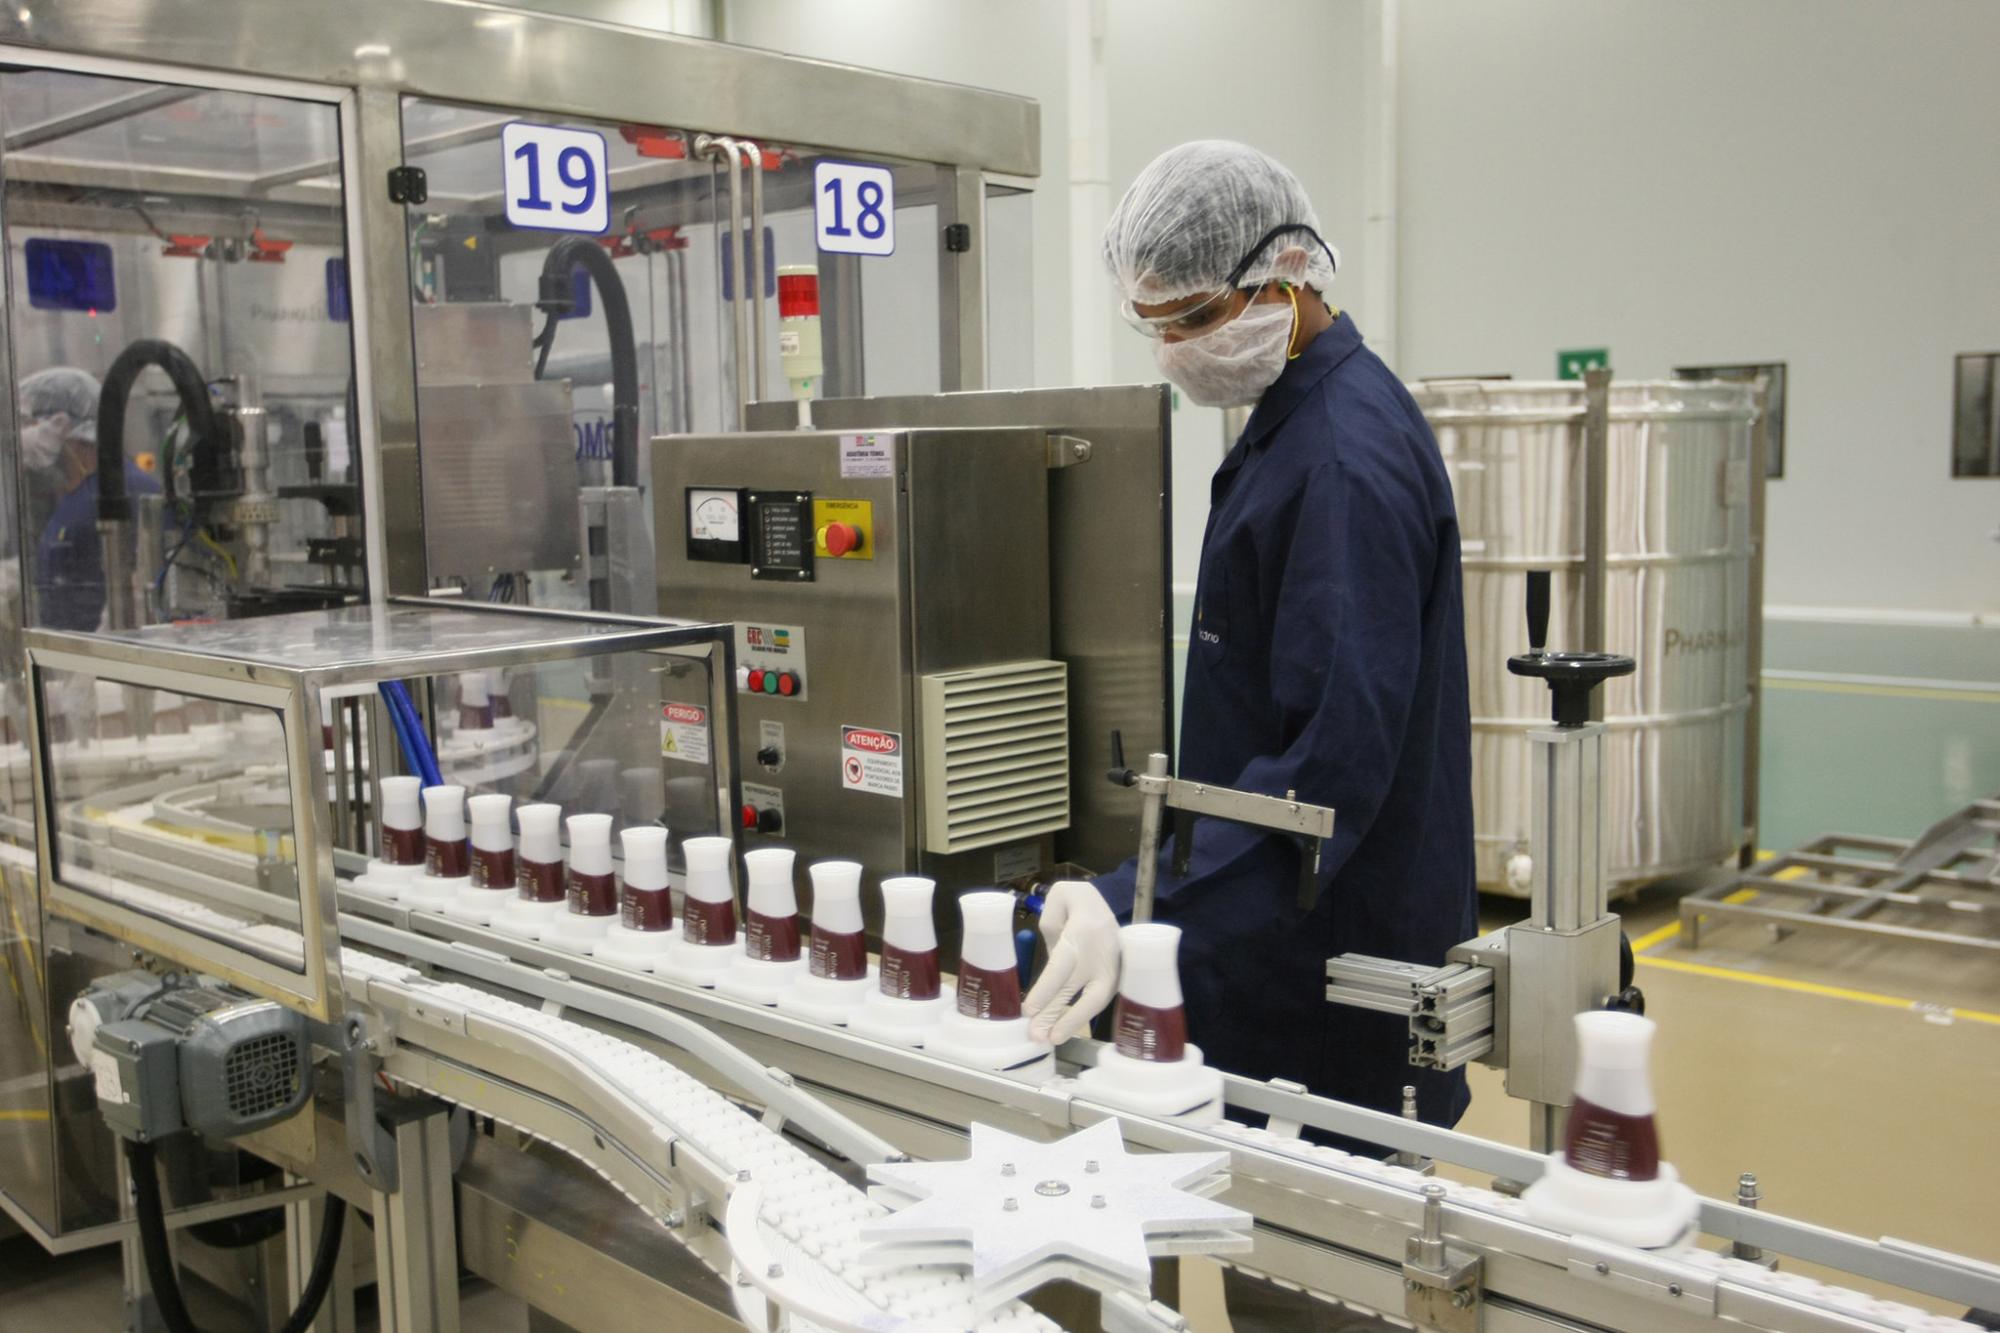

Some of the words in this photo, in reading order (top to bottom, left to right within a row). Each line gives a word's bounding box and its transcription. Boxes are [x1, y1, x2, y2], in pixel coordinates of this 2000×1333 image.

[514, 142, 597, 215] 19
[824, 178, 886, 240] 18
[668, 706, 700, 721] PERIGO
[850, 734, 894, 750] ATENÇÃO
